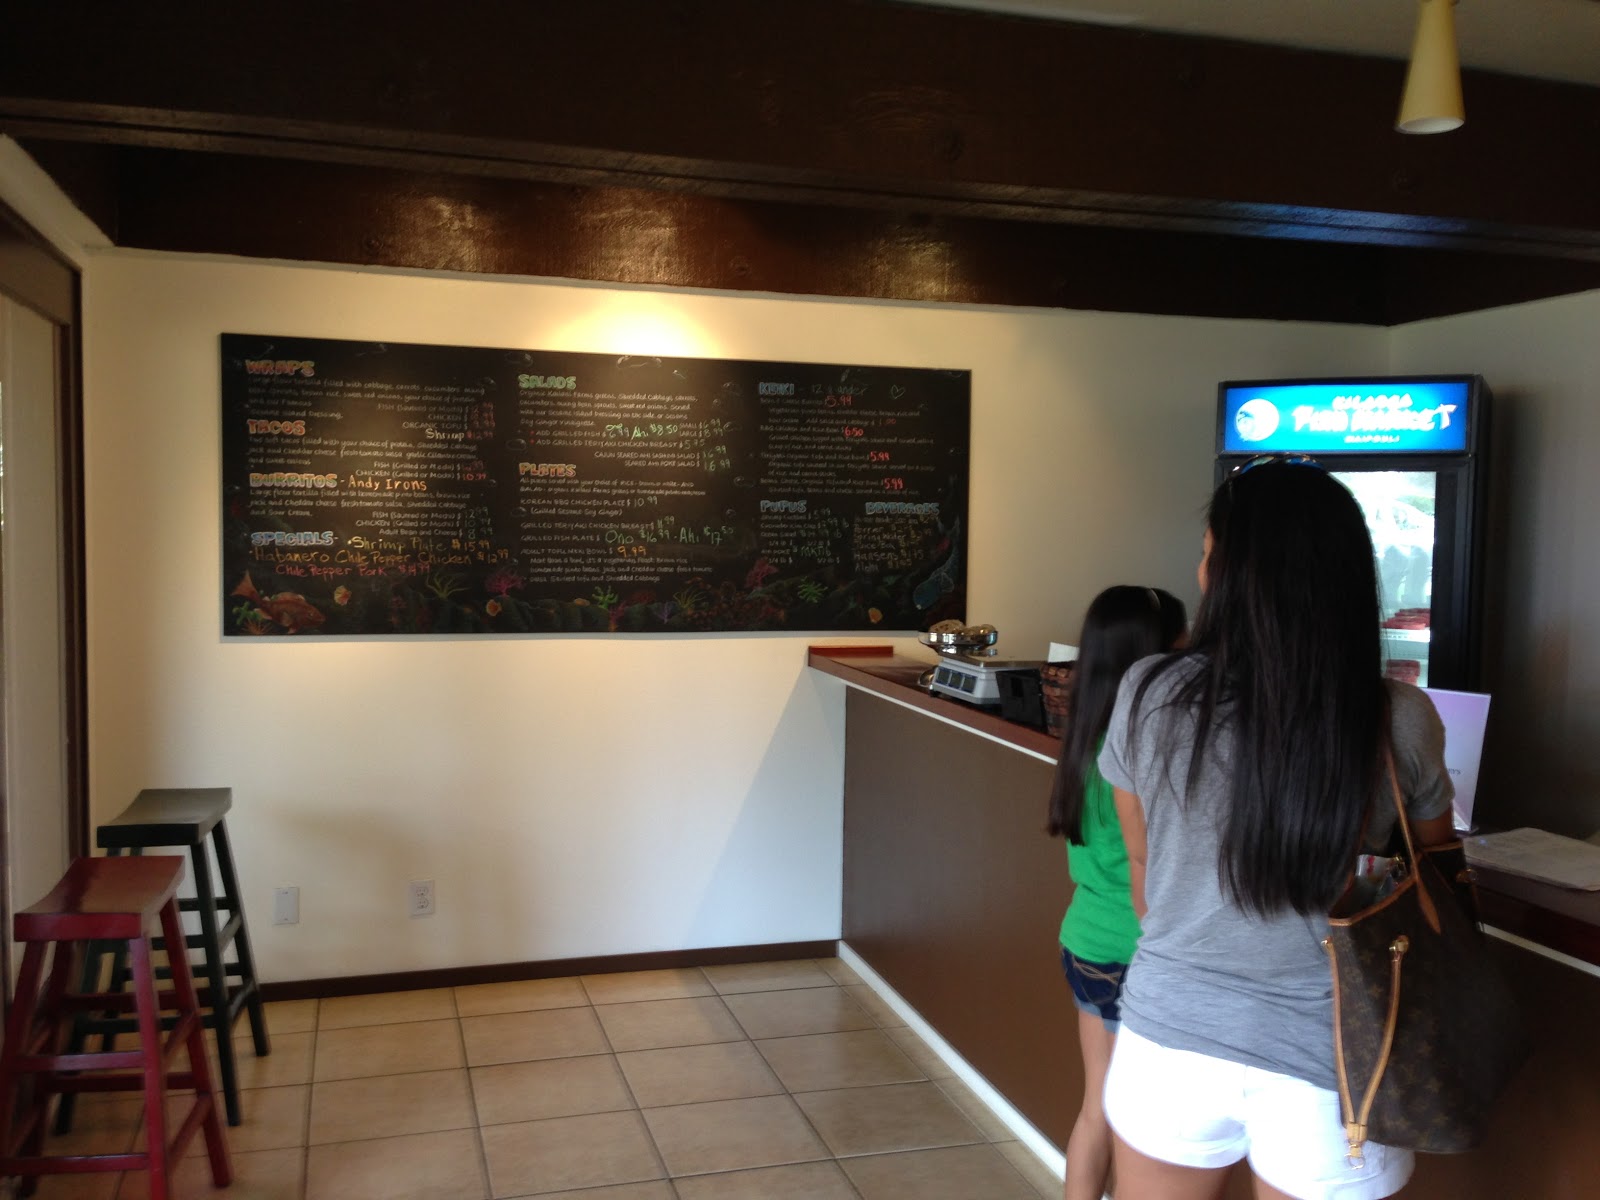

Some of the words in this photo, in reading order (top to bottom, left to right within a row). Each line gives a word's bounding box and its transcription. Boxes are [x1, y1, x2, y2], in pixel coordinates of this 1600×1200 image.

[518, 373, 577, 390] SALADS
[247, 419, 306, 436] TACOS
[518, 462, 577, 477] PLATES
[249, 472, 338, 489] BURRITOS
